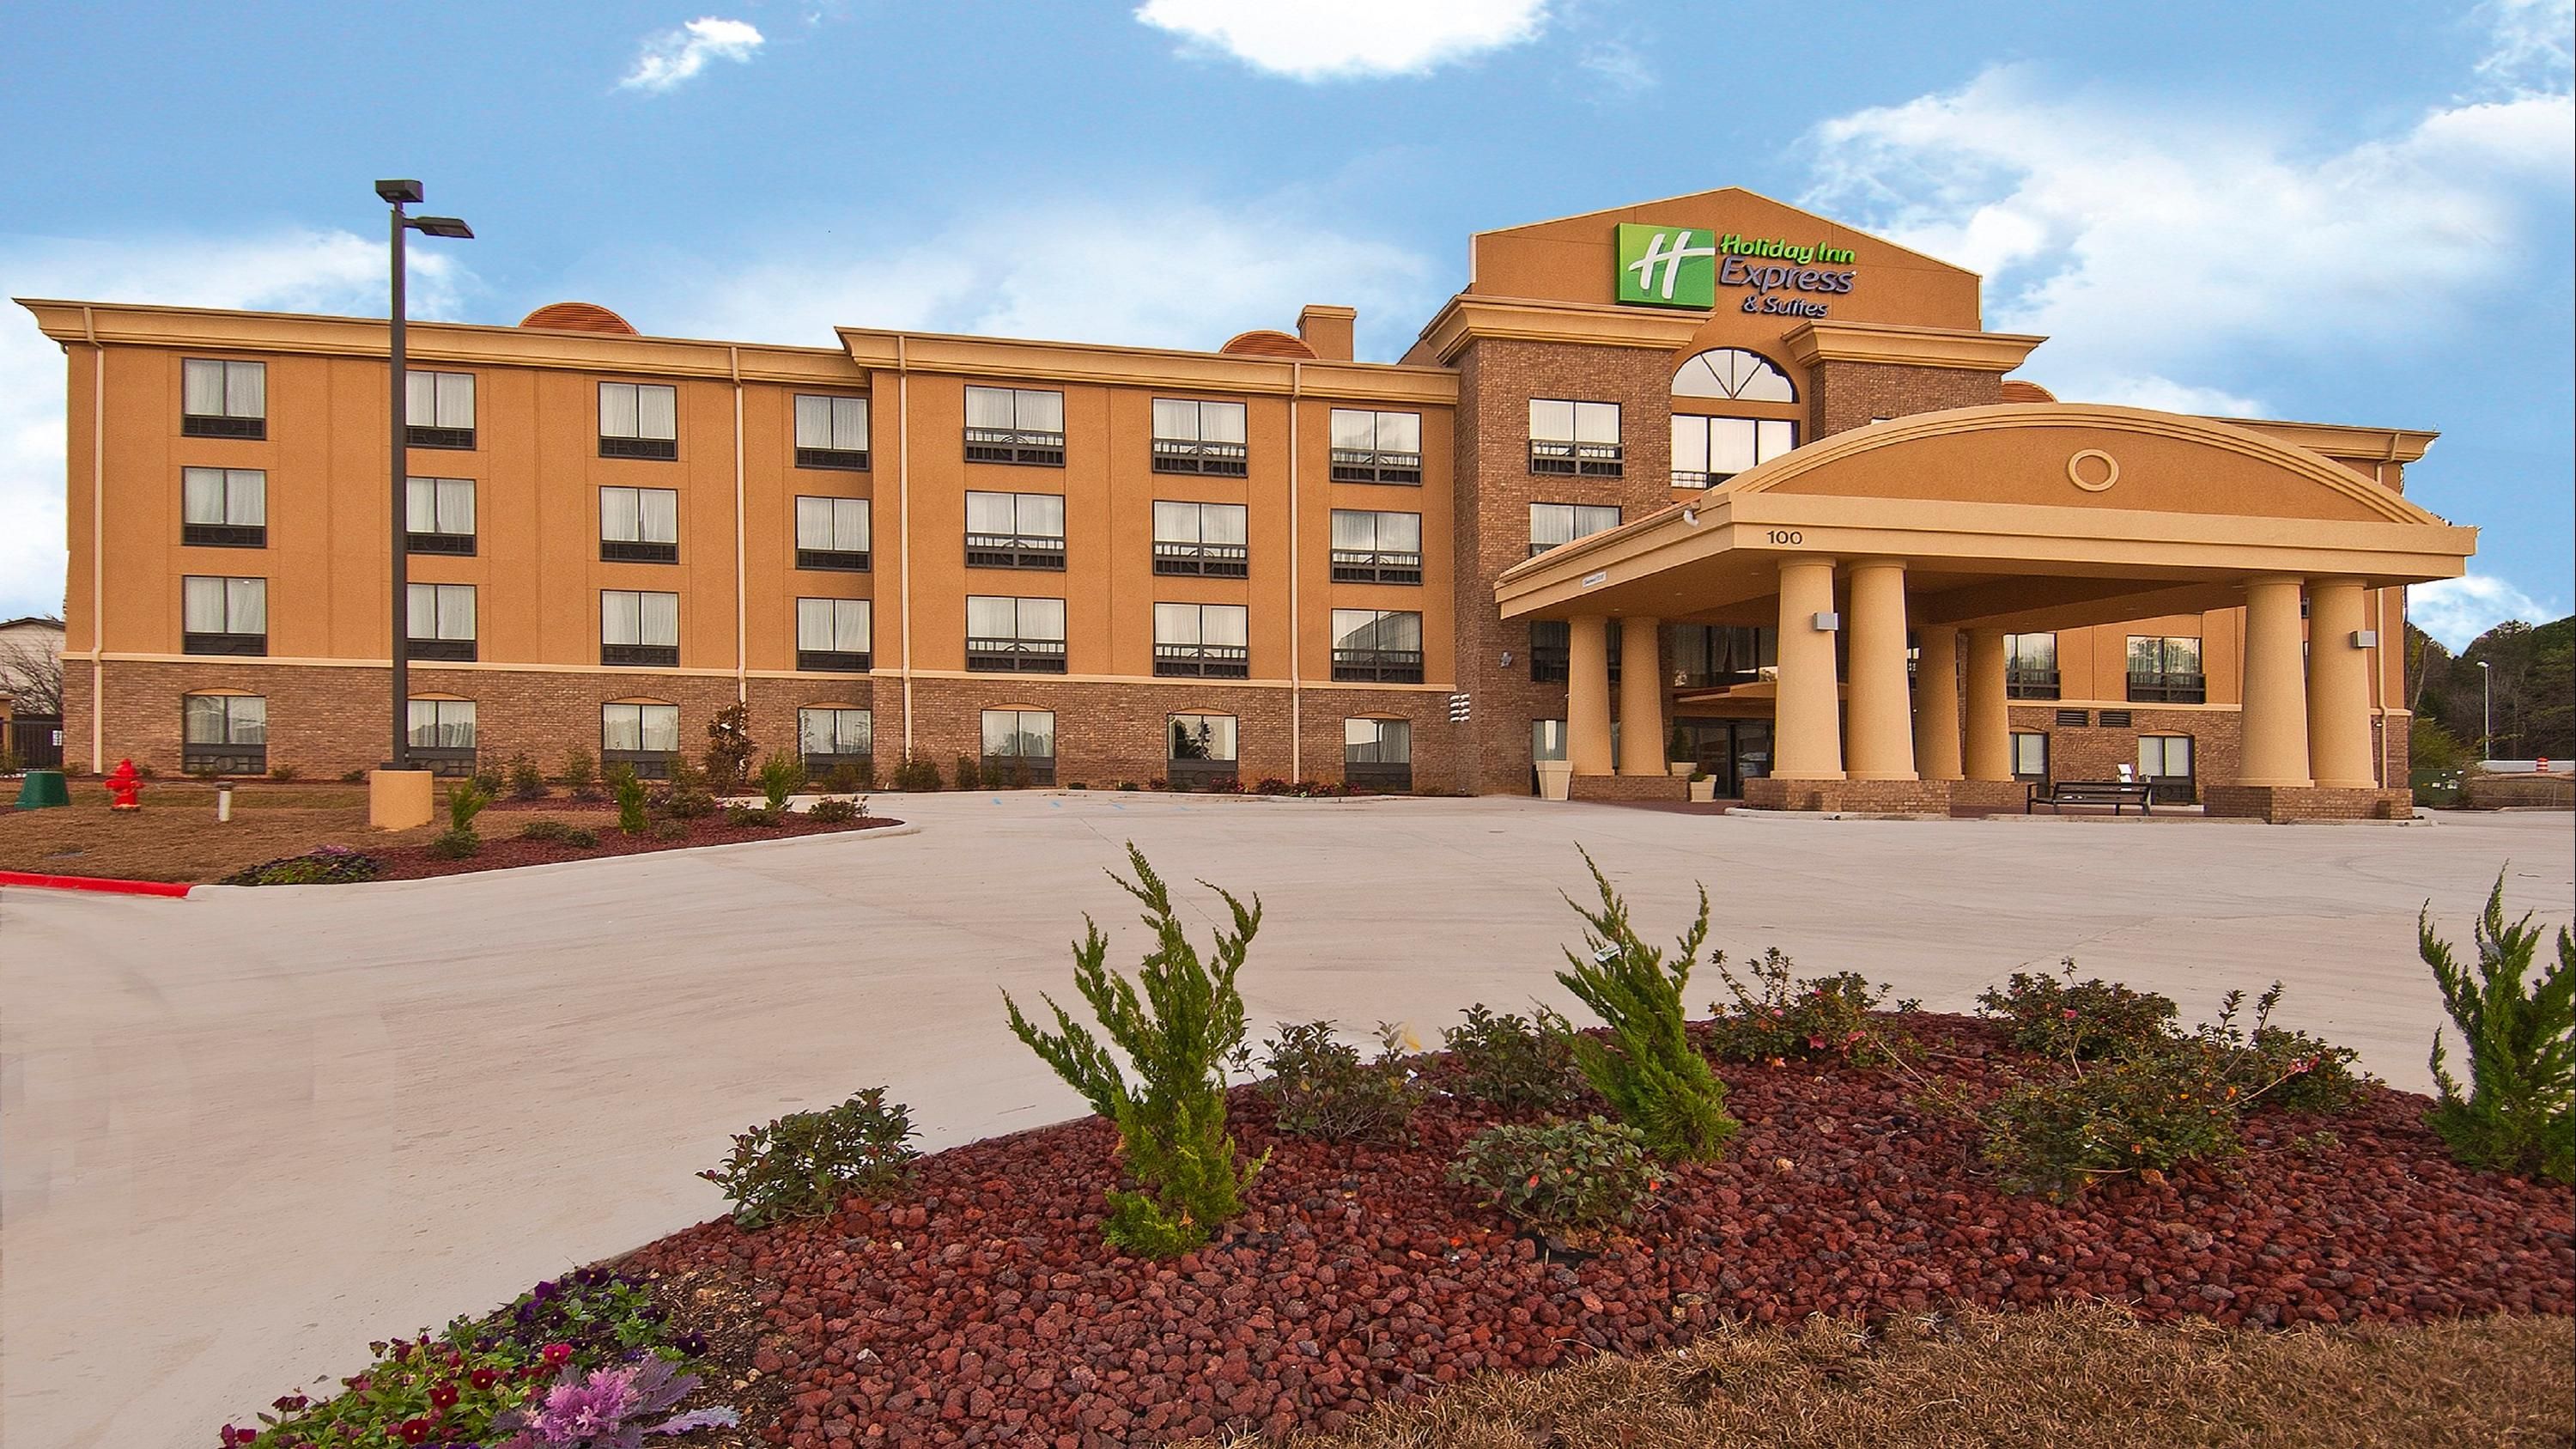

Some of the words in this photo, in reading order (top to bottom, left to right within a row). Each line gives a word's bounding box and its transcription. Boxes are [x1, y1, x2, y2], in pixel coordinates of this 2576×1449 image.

[1721, 233, 1814, 264] Holiday
[1816, 241, 1856, 263] Inn
[1720, 257, 1855, 295] Express
[1742, 295, 1758, 314] &
[1765, 296, 1829, 318] Suites
[1766, 530, 1803, 545] 100
